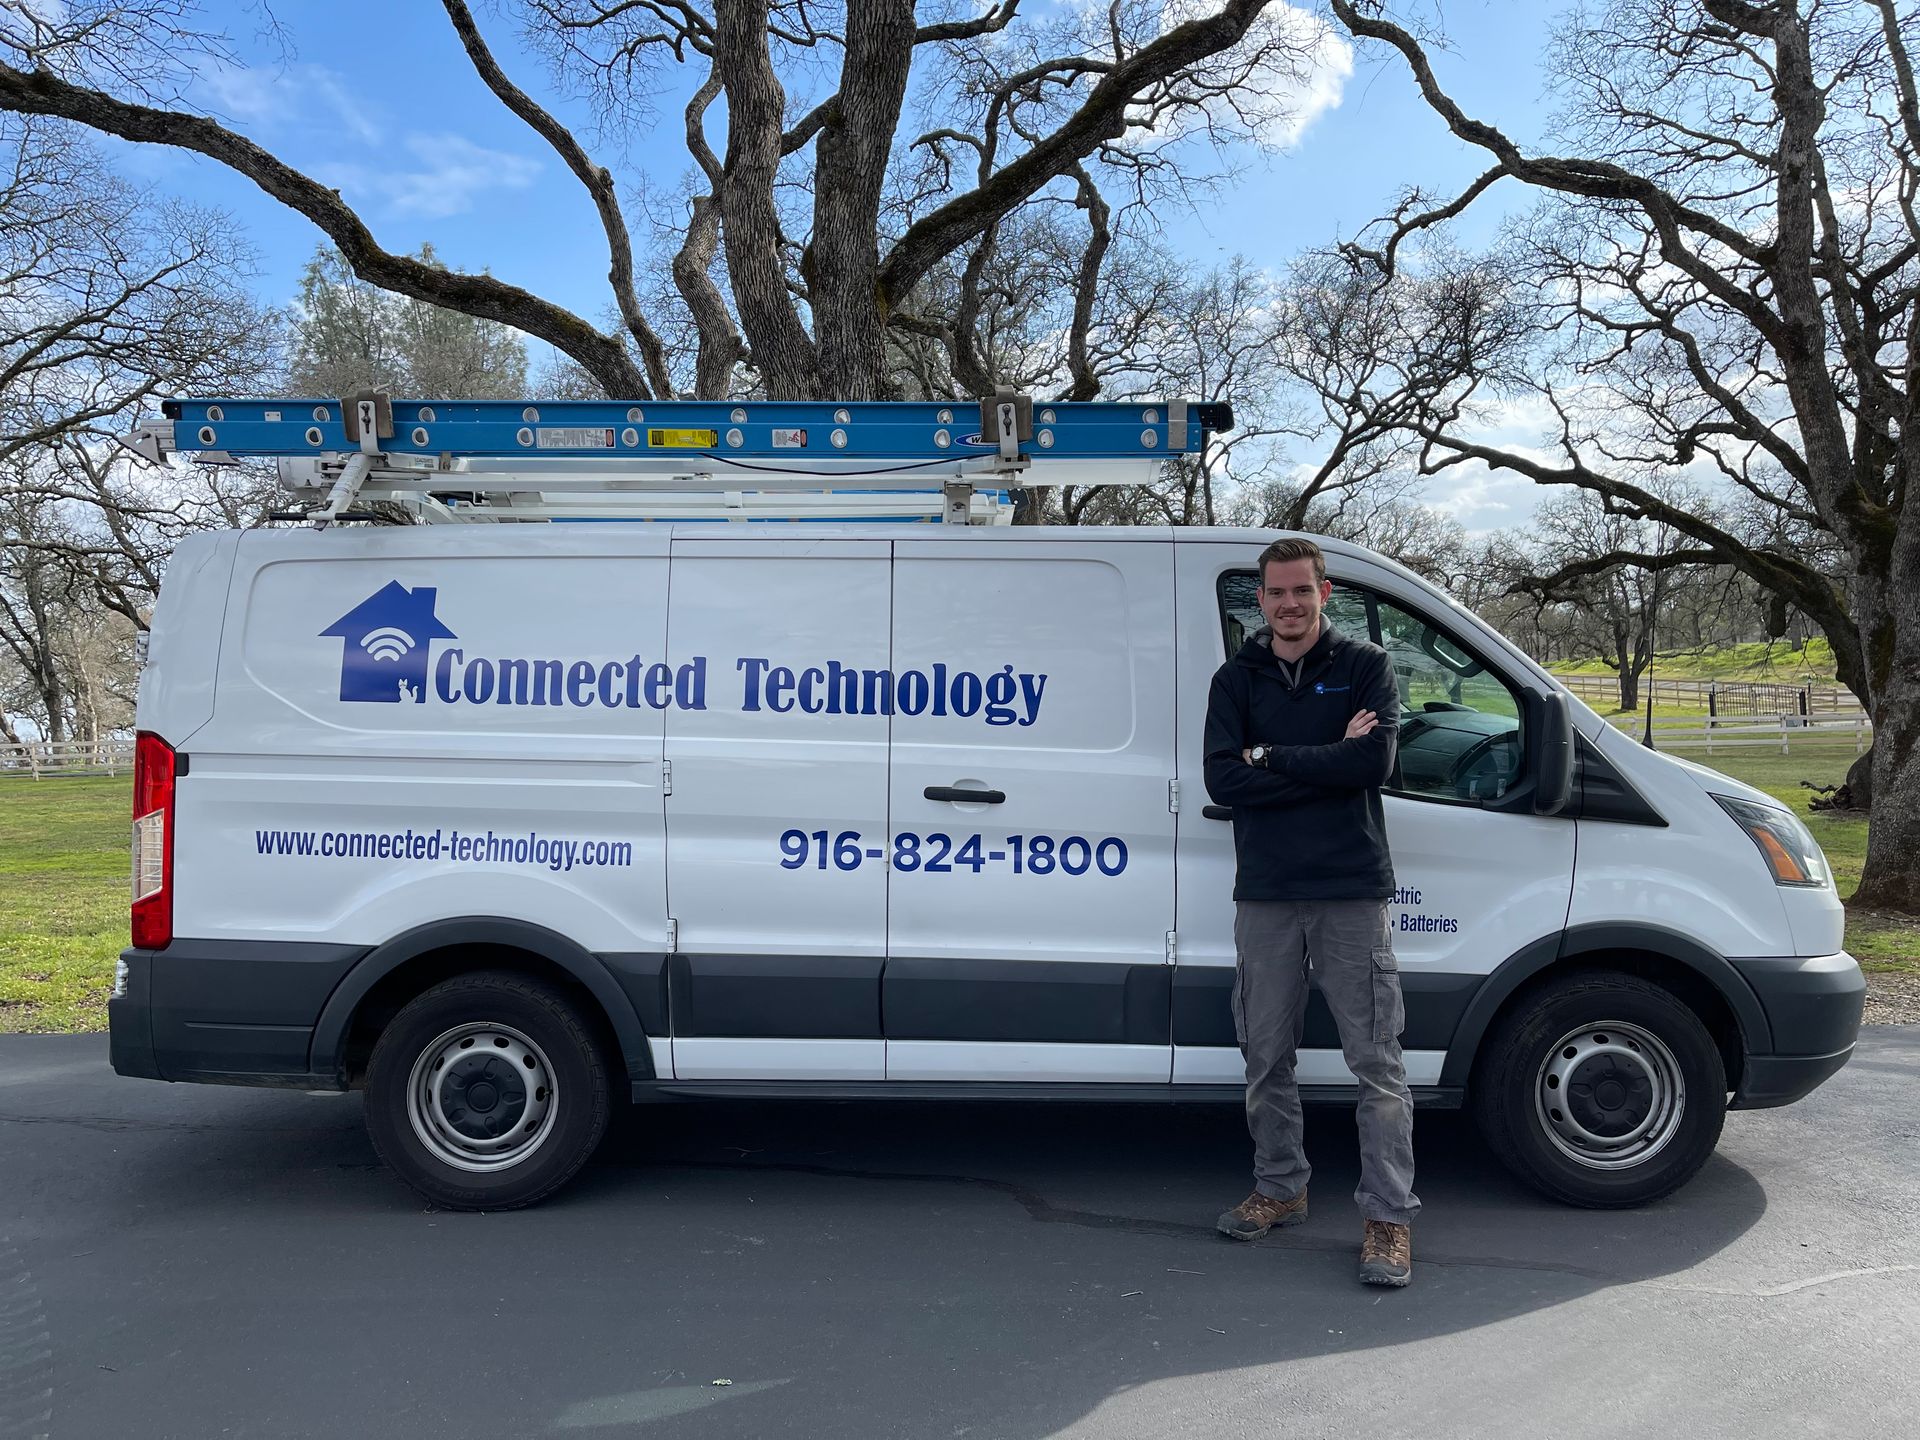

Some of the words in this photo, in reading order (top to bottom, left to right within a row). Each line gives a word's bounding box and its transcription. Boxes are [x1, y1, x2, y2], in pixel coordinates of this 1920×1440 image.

[435, 648, 708, 711] Connected
[736, 657, 1048, 727] Technology
[255, 829, 632, 871] www.connected-technology.com
[1388, 886, 1422, 905] ctric
[1400, 913, 1458, 933] Batteries
